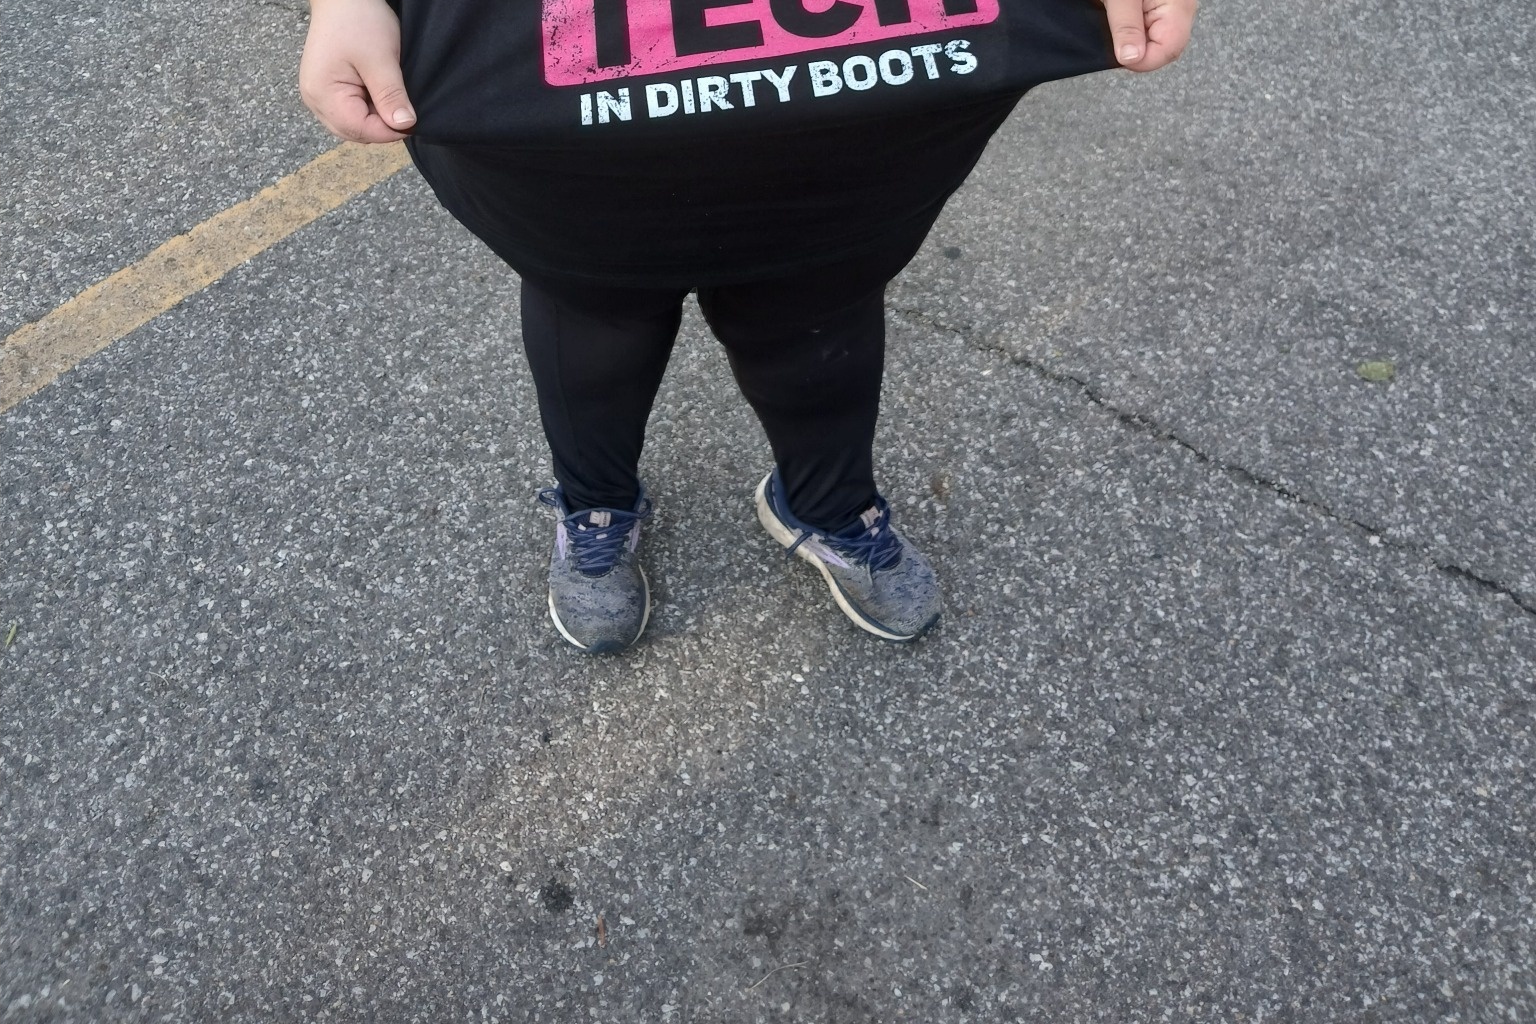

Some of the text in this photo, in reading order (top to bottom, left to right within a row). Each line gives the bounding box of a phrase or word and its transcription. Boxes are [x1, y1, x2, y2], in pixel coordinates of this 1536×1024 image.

[580, 39, 978, 126] IN DIRTY BOOTS
